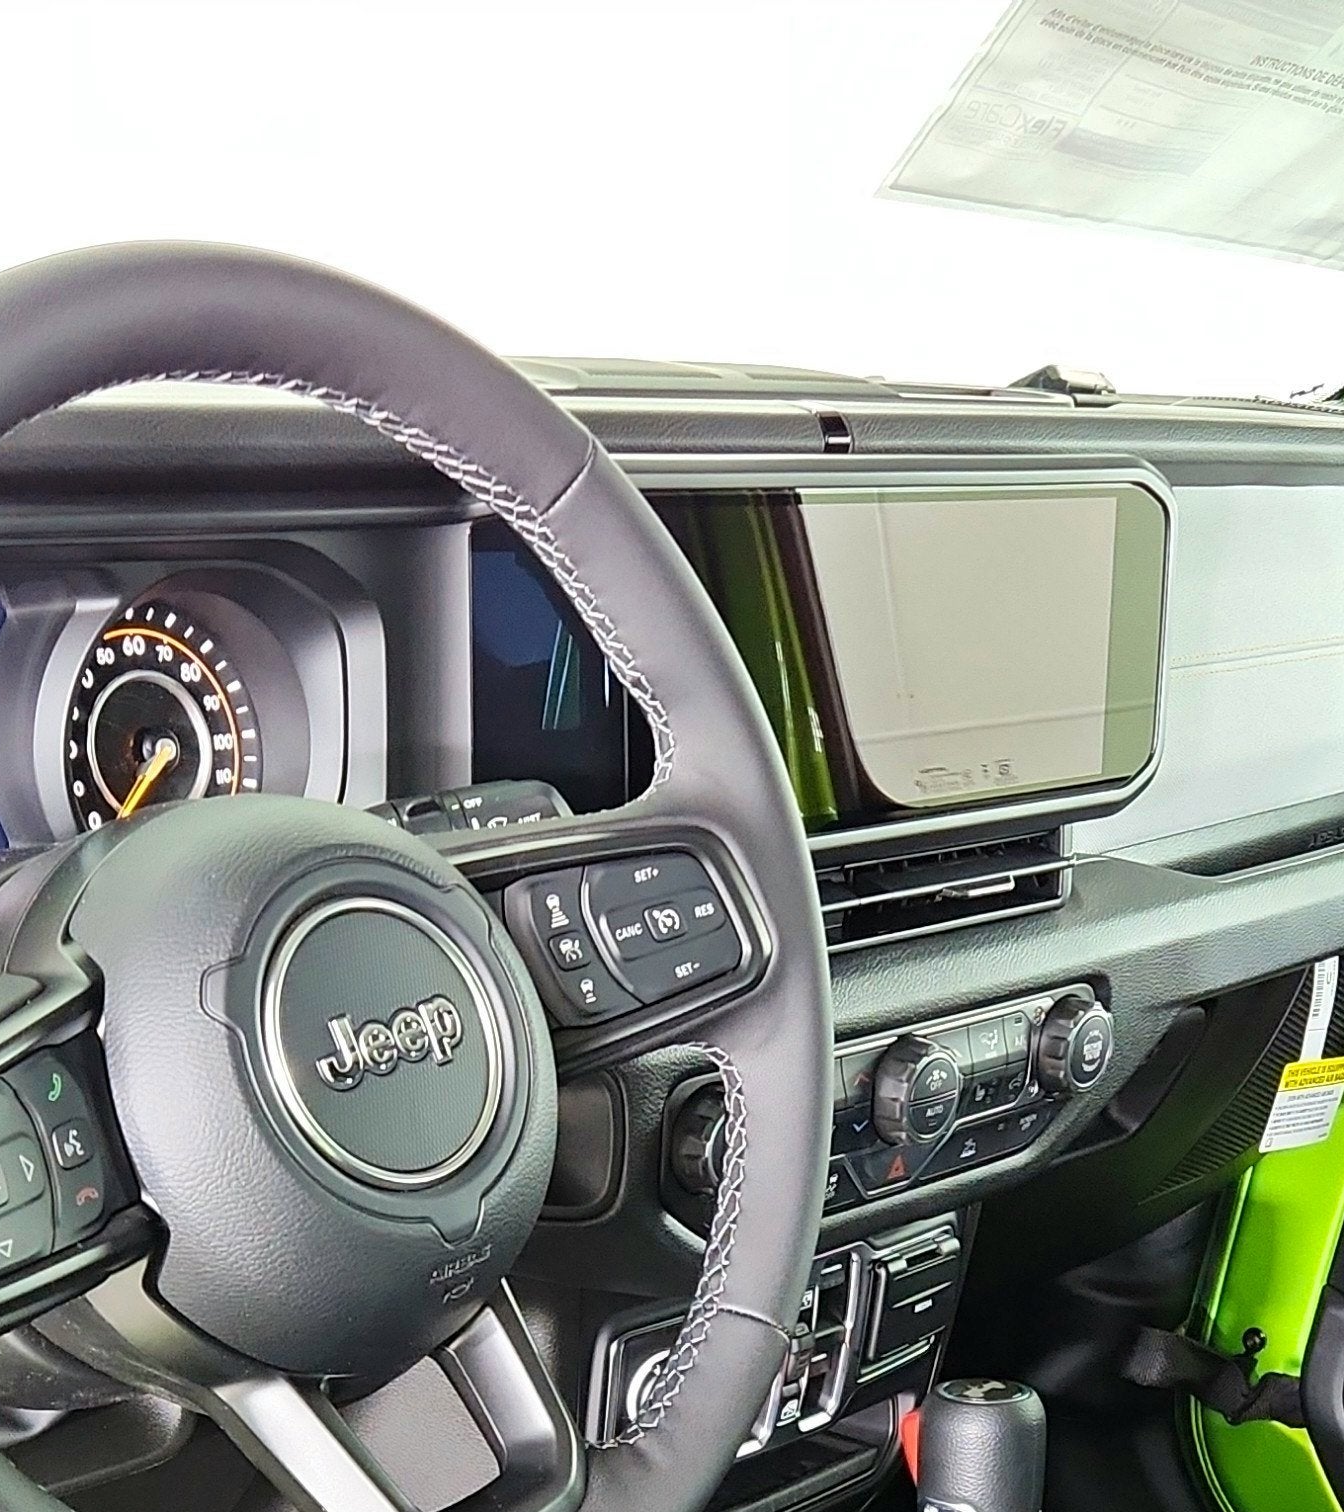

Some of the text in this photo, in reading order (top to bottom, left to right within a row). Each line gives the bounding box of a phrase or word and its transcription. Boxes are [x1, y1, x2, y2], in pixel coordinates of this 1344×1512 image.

[1249, 54, 1315, 80] INSTRUCTIONS
[1312, 68, 1328, 82] DE
[122, 634, 146, 656] 60
[155, 644, 174, 663] 70
[96, 647, 115, 666] 50
[180, 661, 202, 682] 80
[203, 694, 221, 712] 90
[213, 733, 233, 751] 100
[215, 767, 233, 785] 110
[463, 796, 483, 809] OFF
[634, 866, 660, 883] SET+
[694, 902, 716, 919] RES
[615, 922, 644, 942] CANC
[315, 993, 464, 1092] Jeep
[930, 1079, 943, 1092] OFF
[925, 1104, 944, 1118] AUTO
